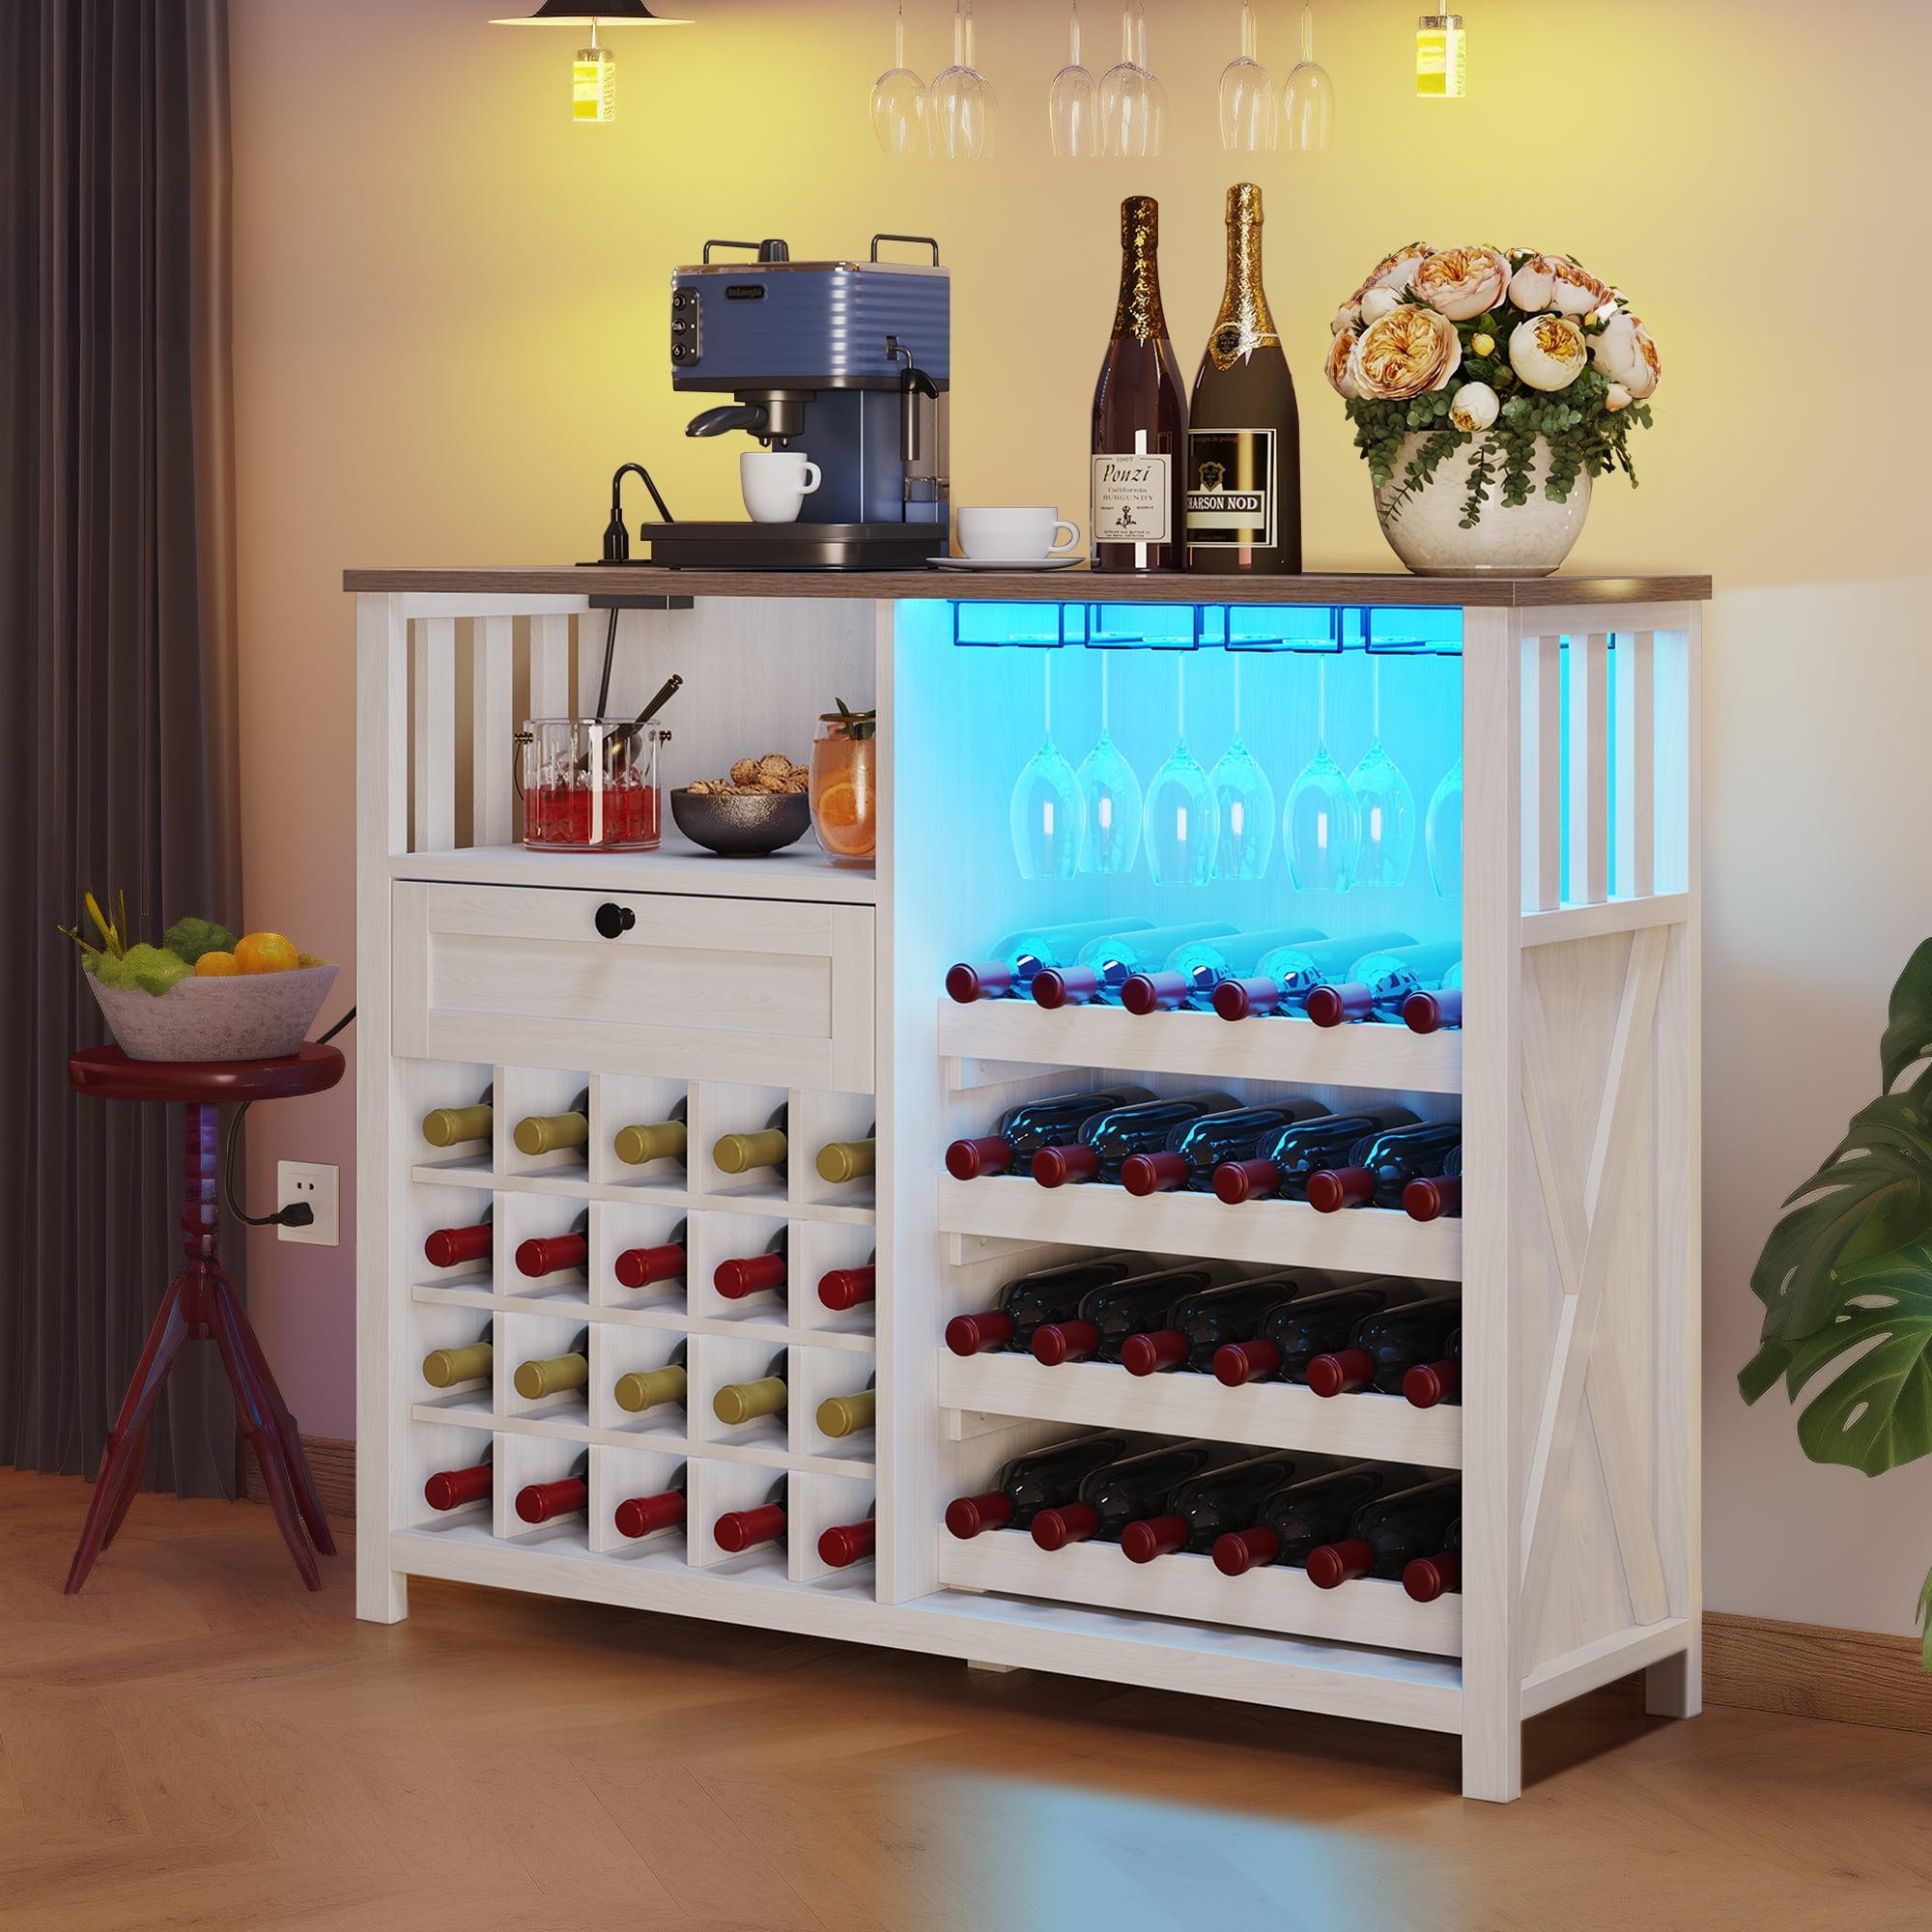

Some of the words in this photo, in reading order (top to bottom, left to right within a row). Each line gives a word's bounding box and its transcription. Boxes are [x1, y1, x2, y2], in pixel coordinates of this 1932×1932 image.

[1103, 464, 1151, 482] Ponzi
[1187, 497, 1225, 510] HARSON
[1227, 497, 1258, 510] NOD
